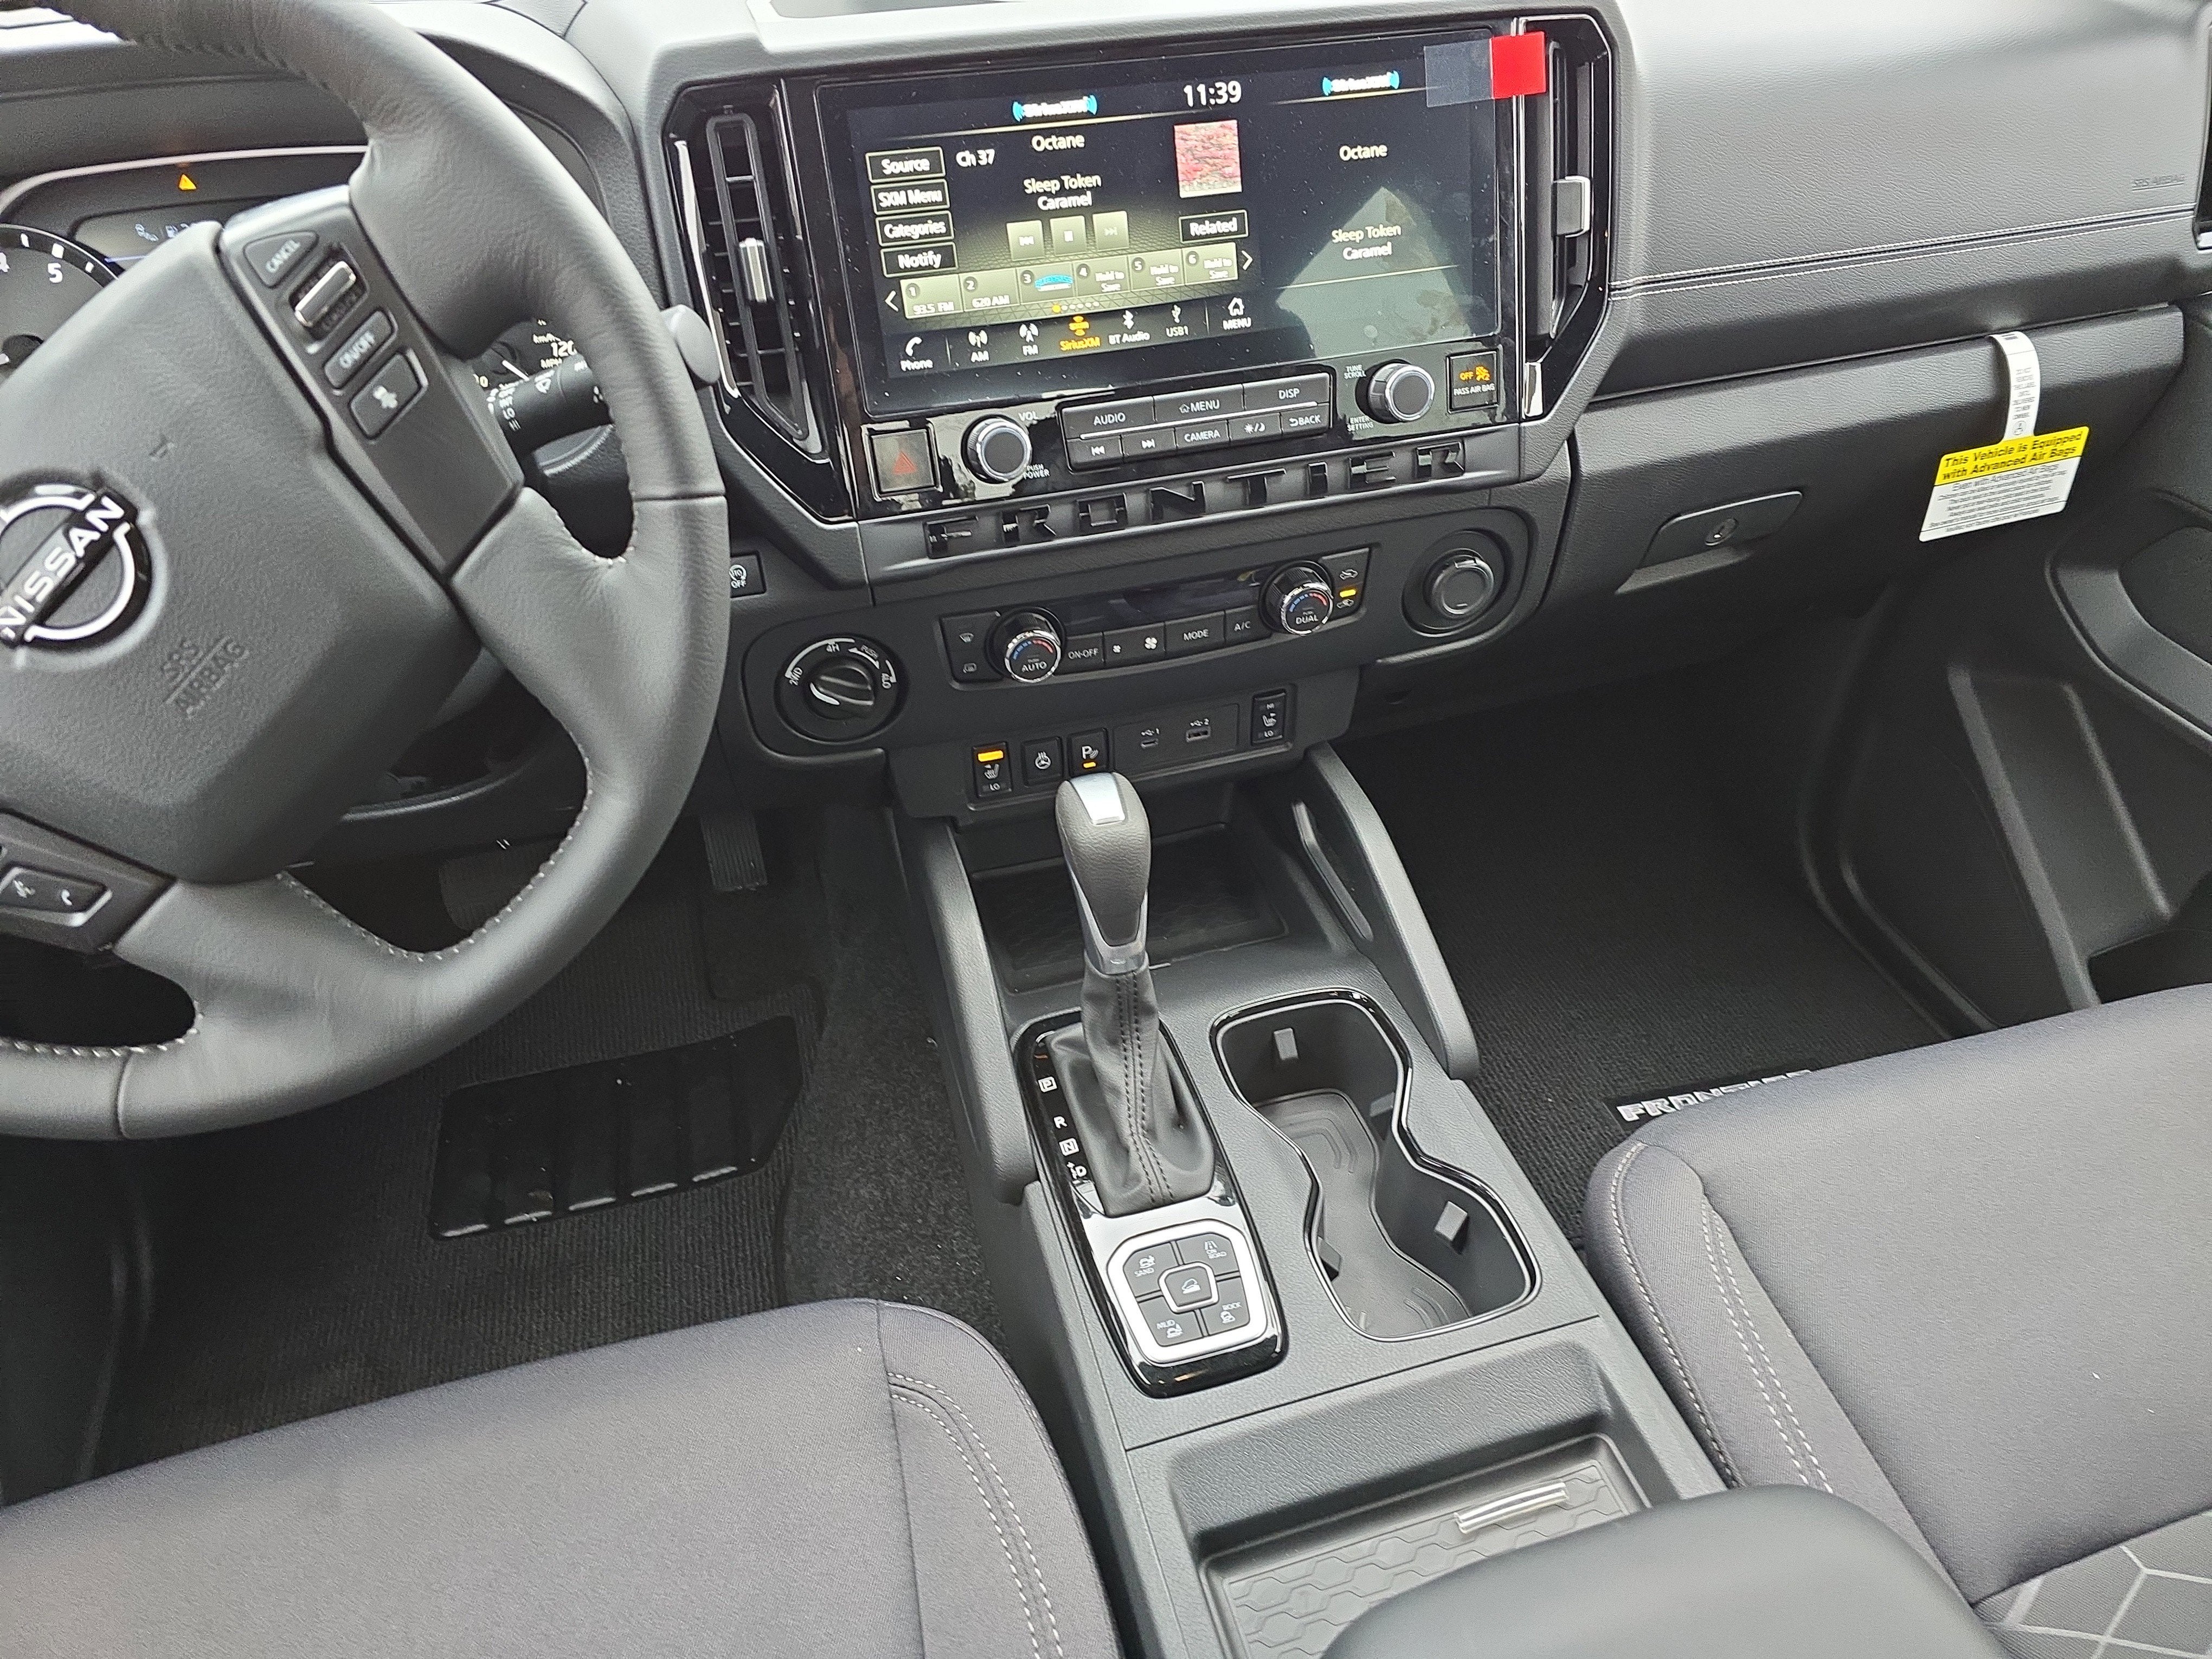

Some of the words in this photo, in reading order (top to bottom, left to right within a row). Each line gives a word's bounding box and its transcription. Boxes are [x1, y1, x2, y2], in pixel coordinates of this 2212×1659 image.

[1184, 81, 1242, 107] 11:39
[1032, 133, 1084, 152] Octane
[956, 150, 976, 167] Ch
[977, 149, 995, 165] 37
[1339, 144, 1387, 161] Octane
[881, 158, 930, 175] Source
[1024, 177, 1060, 194] Sleep
[1061, 173, 1102, 190] Token
[878, 190, 908, 208] SXM
[908, 189, 943, 204] Menu
[1038, 191, 1092, 211] Caramel
[884, 220, 946, 239] Categories
[1190, 217, 1238, 236] Related
[1332, 228, 1364, 243] Sleep
[1365, 223, 1401, 240] Token
[1343, 242, 1392, 260] Caramel
[898, 250, 942, 269] Notify
[1188, 255, 1197, 264] 6
[1079, 267, 1088, 277] 4
[1134, 261, 1142, 271] 5
[48, 262, 63, 284] 5
[1022, 273, 1031, 284] 3
[909, 286, 916, 297] 1
[966, 281, 975, 290] 2
[937, 301, 954, 312] FM
[972, 297, 992, 308] 620
[992, 294, 1010, 306] AM
[1223, 317, 1251, 330] MENU
[1166, 326, 1188, 337] USB1
[1060, 337, 1101, 351] SiriusXM
[1109, 334, 1122, 345] BT
[1122, 331, 1150, 343] Audio
[971, 351, 989, 362] AM
[1023, 345, 1038, 356] FM
[901, 359, 933, 371] Phone
[1459, 371, 1474, 381] OFF
[1278, 388, 1300, 400] DISP
[1454, 387, 1470, 396] PASS
[1470, 385, 1482, 394] AIR
[1482, 383, 1495, 392] BAG
[1191, 399, 1220, 412] MENU
[1018, 410, 1039, 422] VOL
[1094, 412, 1126, 426] AUDIO
[1299, 414, 1321, 426] BACK
[1184, 429, 1220, 443] CAMERA
[1945, 455, 1969, 467] This
[1973, 446, 2015, 462] Vehicle
[2032, 432, 2083, 451] Equipped
[1943, 467, 1967, 480] with
[1970, 454, 2028, 475] Advanced
[2029, 451, 2047, 461] Air
[2048, 446, 2078, 458] Bags
[1023, 469, 1050, 480] POWER
[924, 442, 1465, 559] FRONTIER
[1296, 615, 1319, 625] DUAL
[1234, 621, 1251, 632] A/C
[1183, 629, 1209, 641] MODE
[826, 642, 840, 653] 4H
[1021, 661, 1047, 672] AUTO
[989, 782, 1000, 791] LO
[1040, 1078, 1054, 1090] P
[1053, 1116, 1068, 1129] R
[1062, 1140, 1077, 1154] N
[1075, 1166, 1087, 1178] D
[1135, 1267, 1155, 1277] SAND
[1222, 1302, 1242, 1311] ROCK
[1156, 1320, 1176, 1329] MUD
